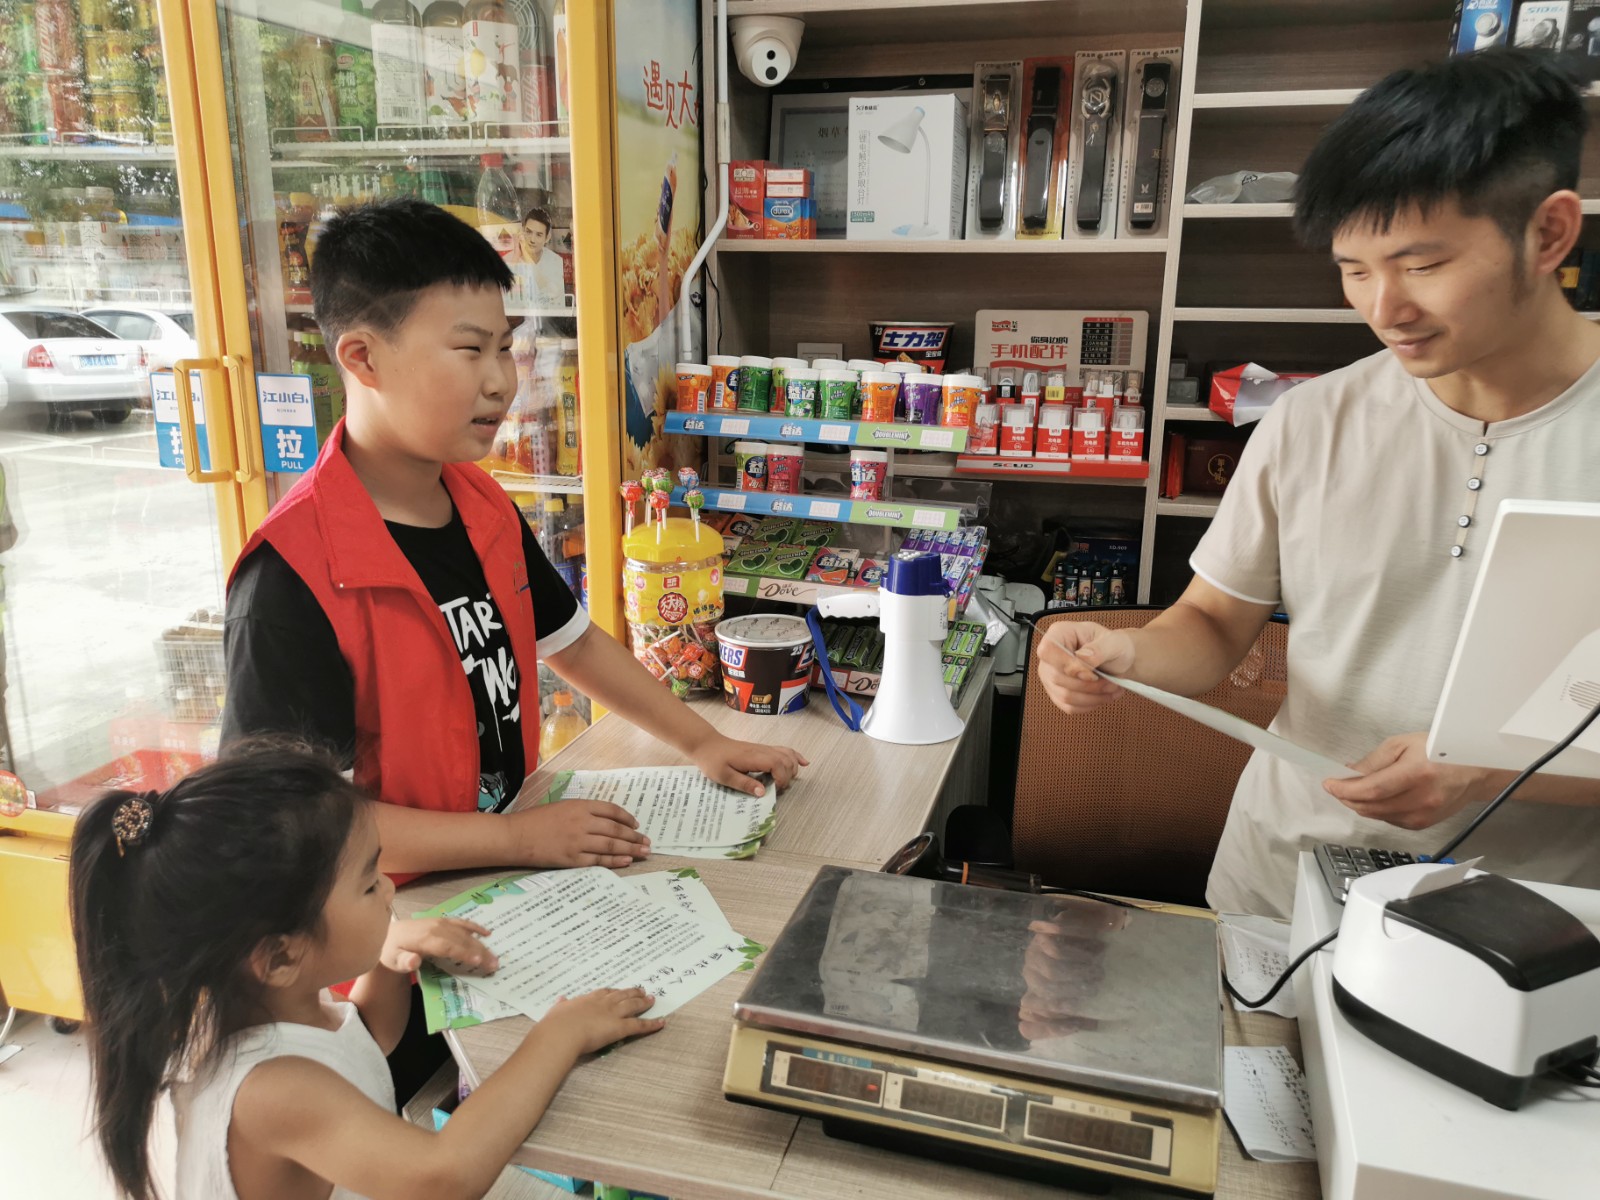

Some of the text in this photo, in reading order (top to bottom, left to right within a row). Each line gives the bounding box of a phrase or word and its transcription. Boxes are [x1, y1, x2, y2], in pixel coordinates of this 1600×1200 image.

[818, 127, 849, 138] 烟草
[883, 332, 944, 347] 士力架
[990, 343, 1069, 359] 手机配件
[263, 391, 305, 404] 江小白
[788, 386, 815, 400] 益达
[685, 420, 803, 436] 益达 益达
[874, 431, 909, 440] DOUBLEMINT
[276, 428, 304, 459] 拉
[281, 460, 304, 470] PULL
[772, 501, 793, 511] 益达
[867, 510, 901, 520] DOUBLEMINT
[819, 556, 848, 567] 益达
[790, 645, 804, 657] 23
